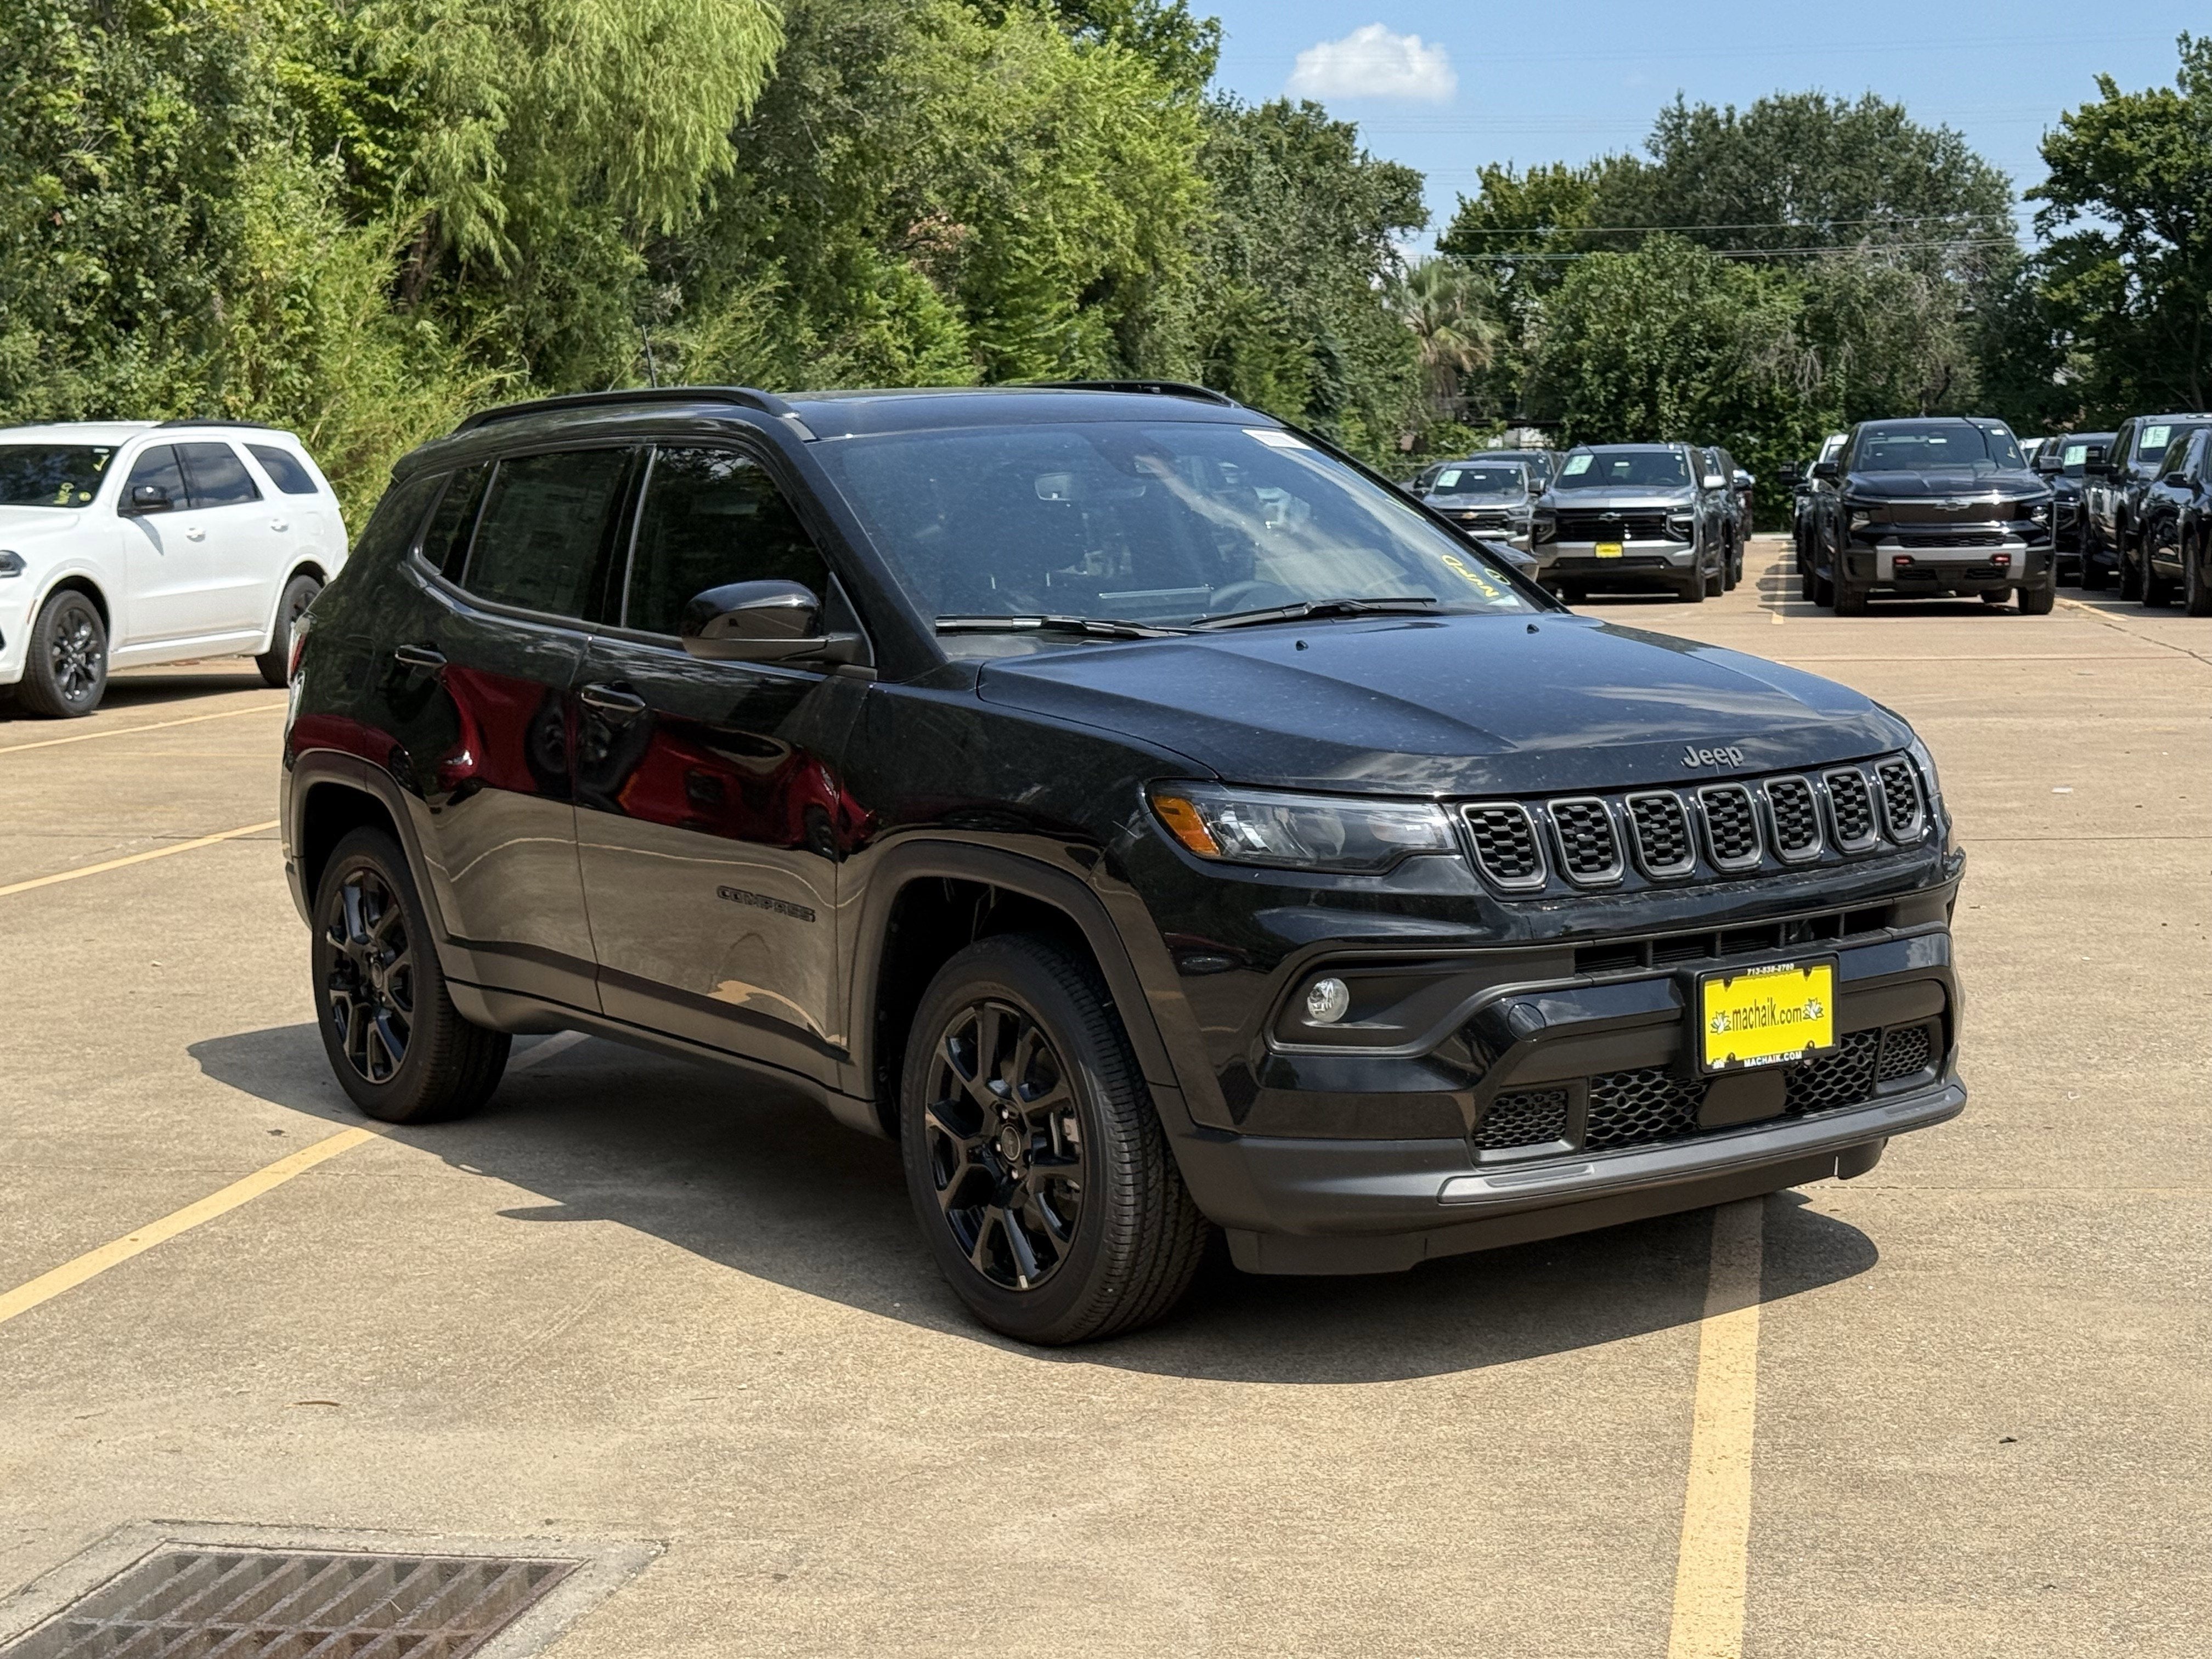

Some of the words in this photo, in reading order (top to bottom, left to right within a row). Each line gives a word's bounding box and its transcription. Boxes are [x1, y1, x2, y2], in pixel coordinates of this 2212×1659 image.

[1682, 746, 1744, 769] Jeep
[1732, 997, 1802, 1031] machaik.com
[1743, 1051, 1803, 1068] MACHAIK.COM
